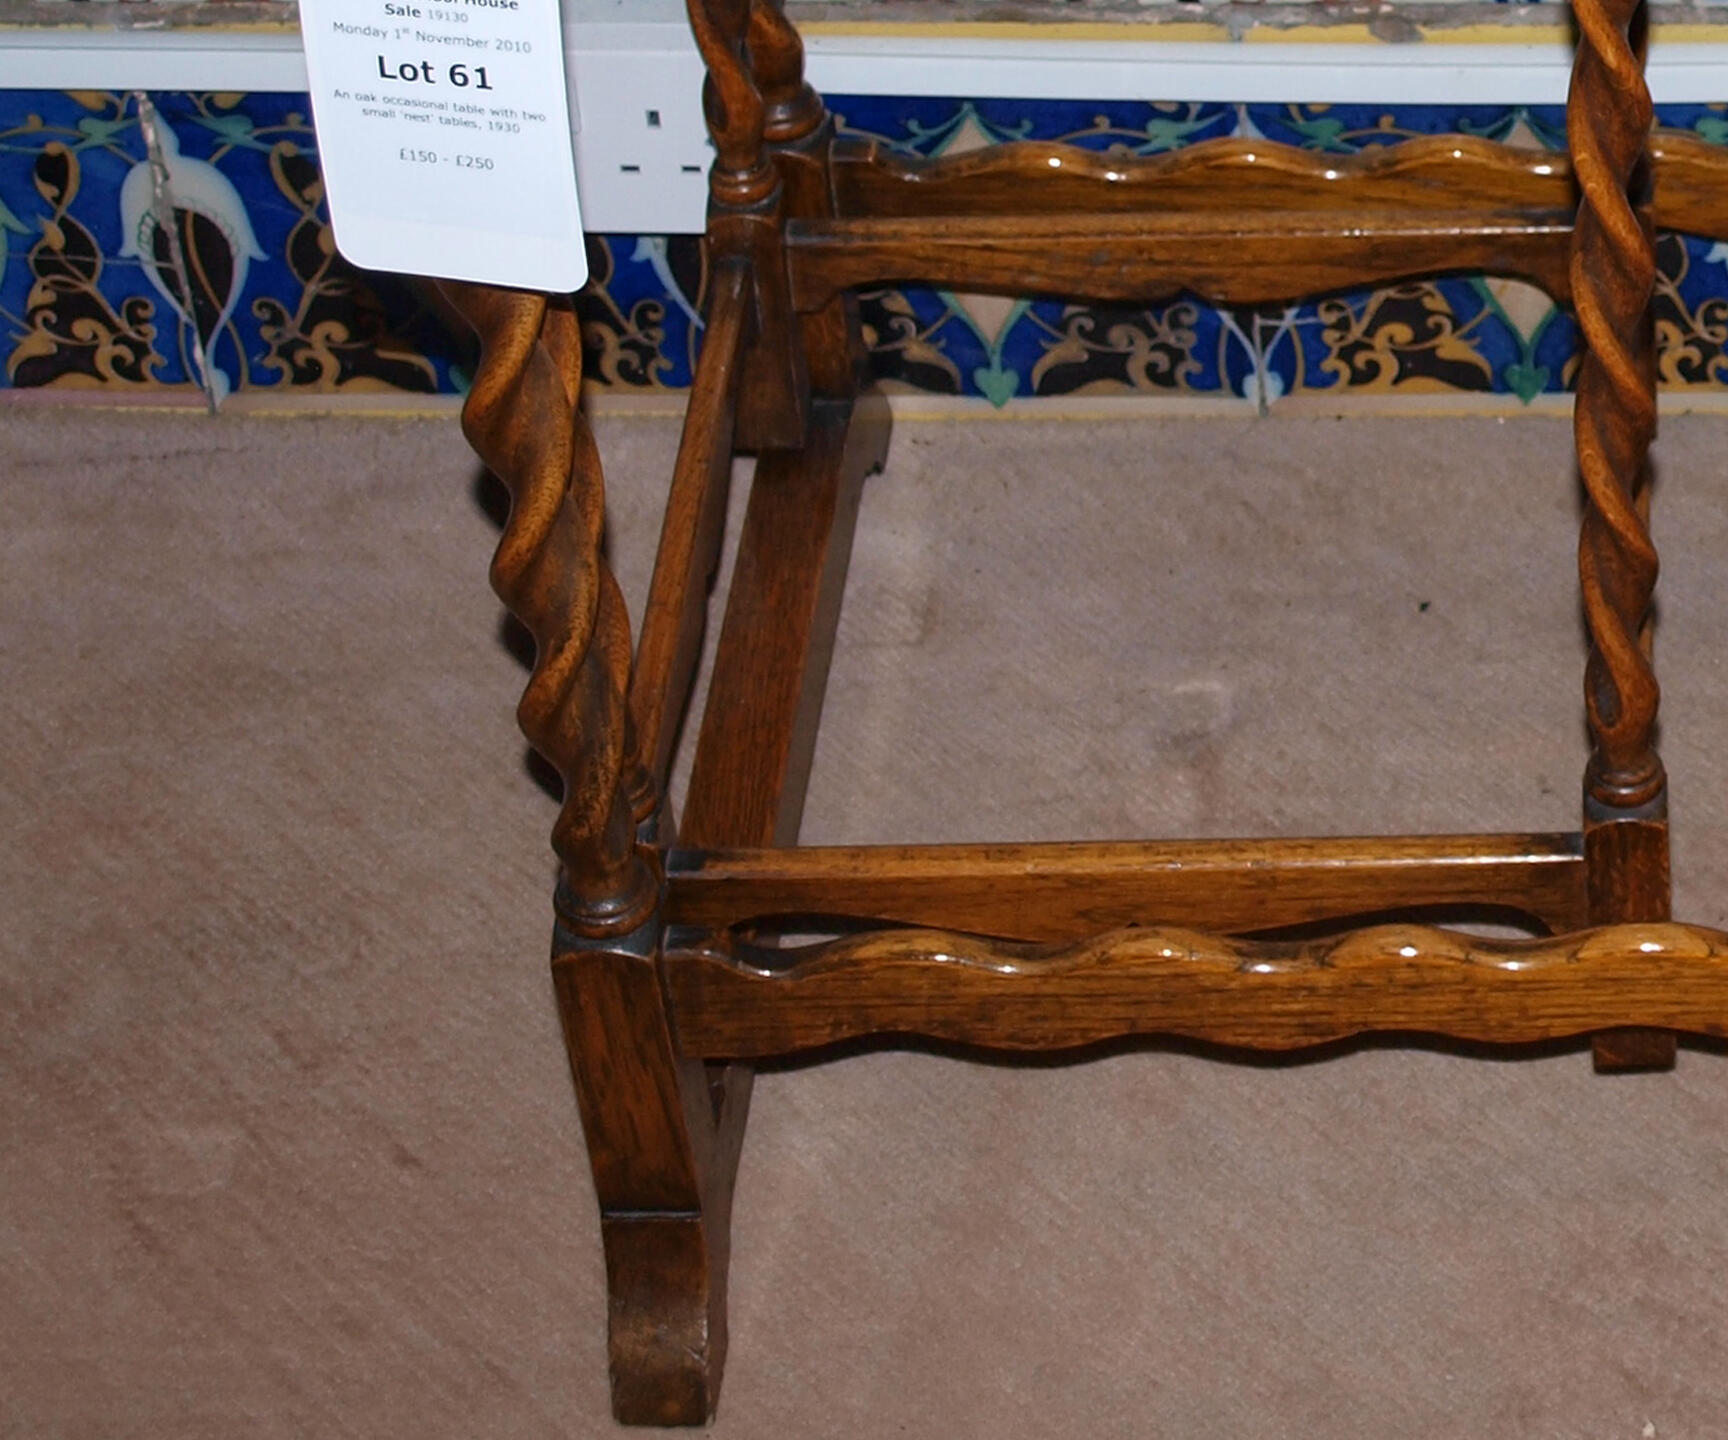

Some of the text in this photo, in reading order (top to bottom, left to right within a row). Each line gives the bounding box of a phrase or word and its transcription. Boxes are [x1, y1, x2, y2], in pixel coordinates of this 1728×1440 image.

[384, 3, 469, 23] Sale 19130
[333, 22, 388, 39] Monday
[416, 30, 488, 48] November
[496, 38, 532, 53] 2010
[377, 55, 493, 90] Lot 61
[334, 89, 546, 122] An oak occasional table with two
[362, 107, 396, 119] small
[489, 120, 521, 134] 1930
[400, 148, 438, 164] £150
[456, 154, 494, 170] £250
